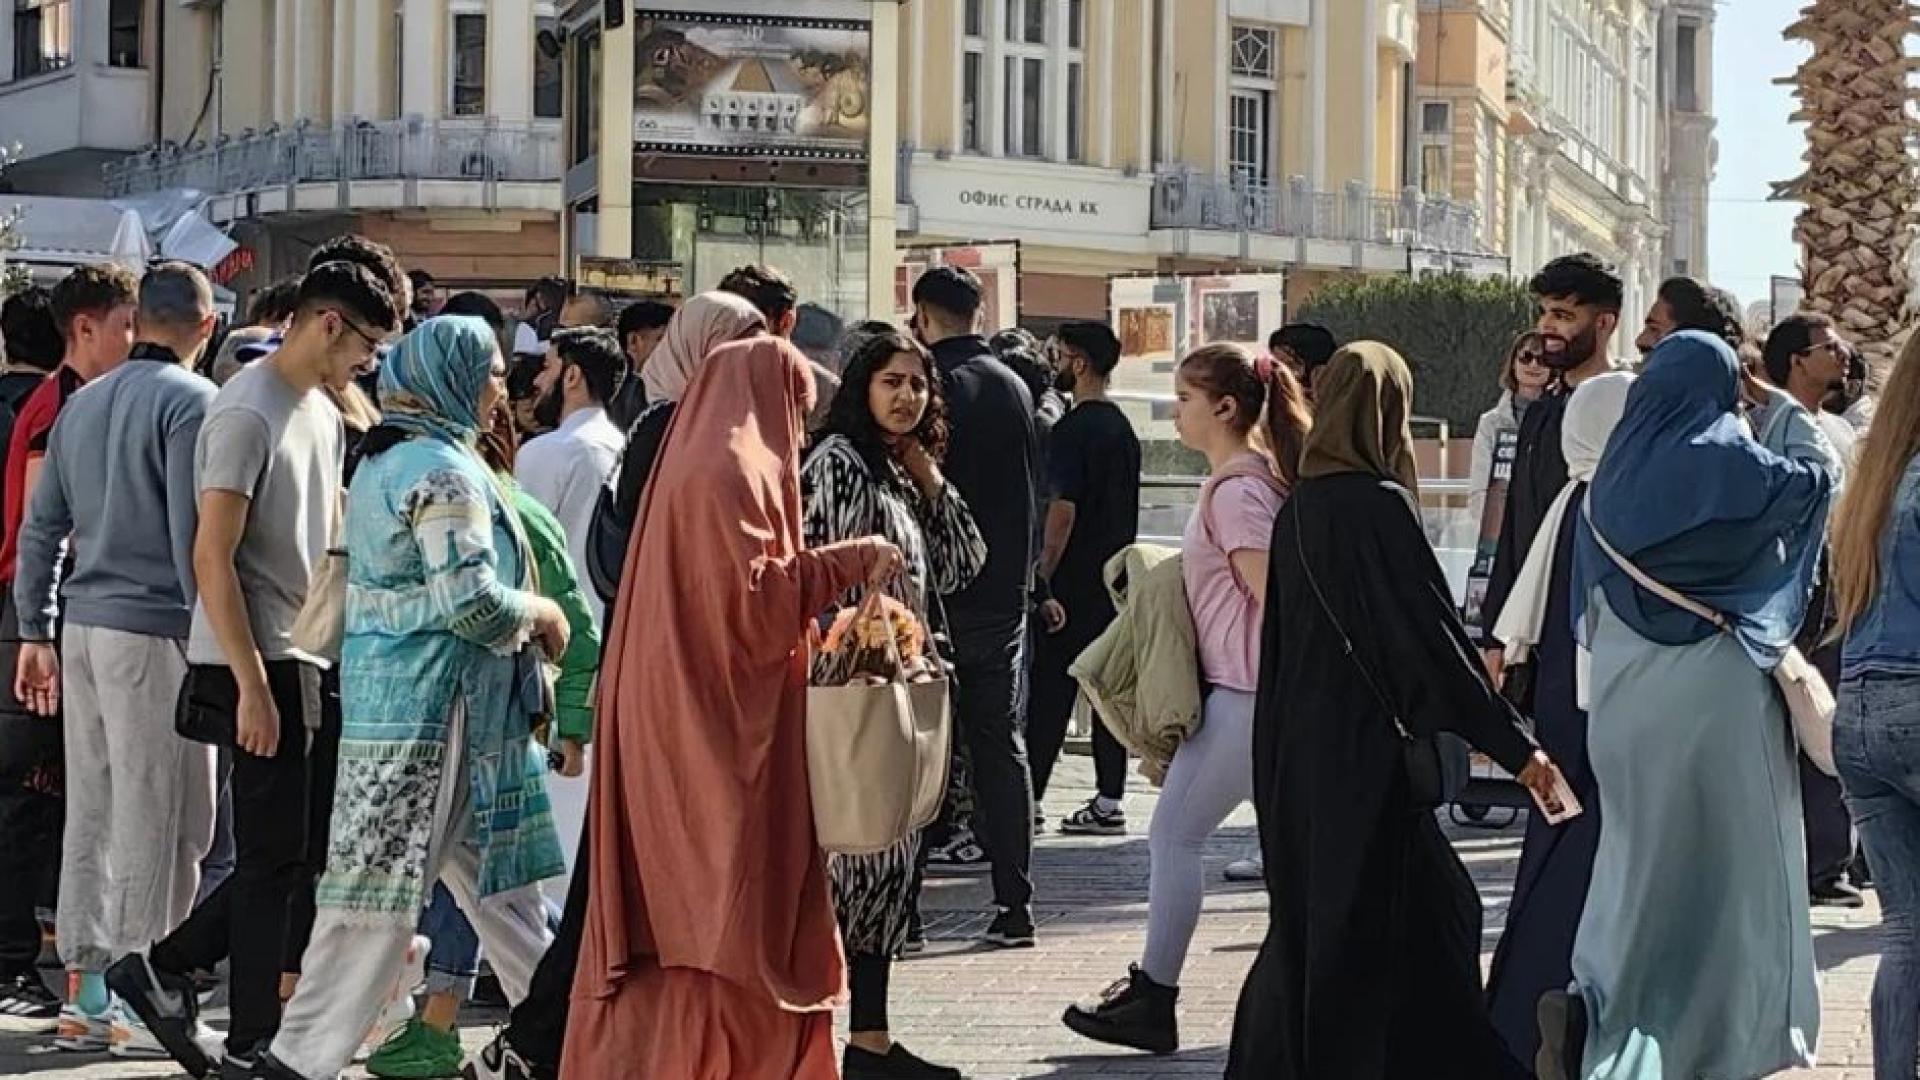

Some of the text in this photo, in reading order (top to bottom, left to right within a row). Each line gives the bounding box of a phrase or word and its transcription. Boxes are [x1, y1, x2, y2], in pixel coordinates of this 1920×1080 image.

[959, 191, 1098, 215] ОФИС СГРАДА КК
